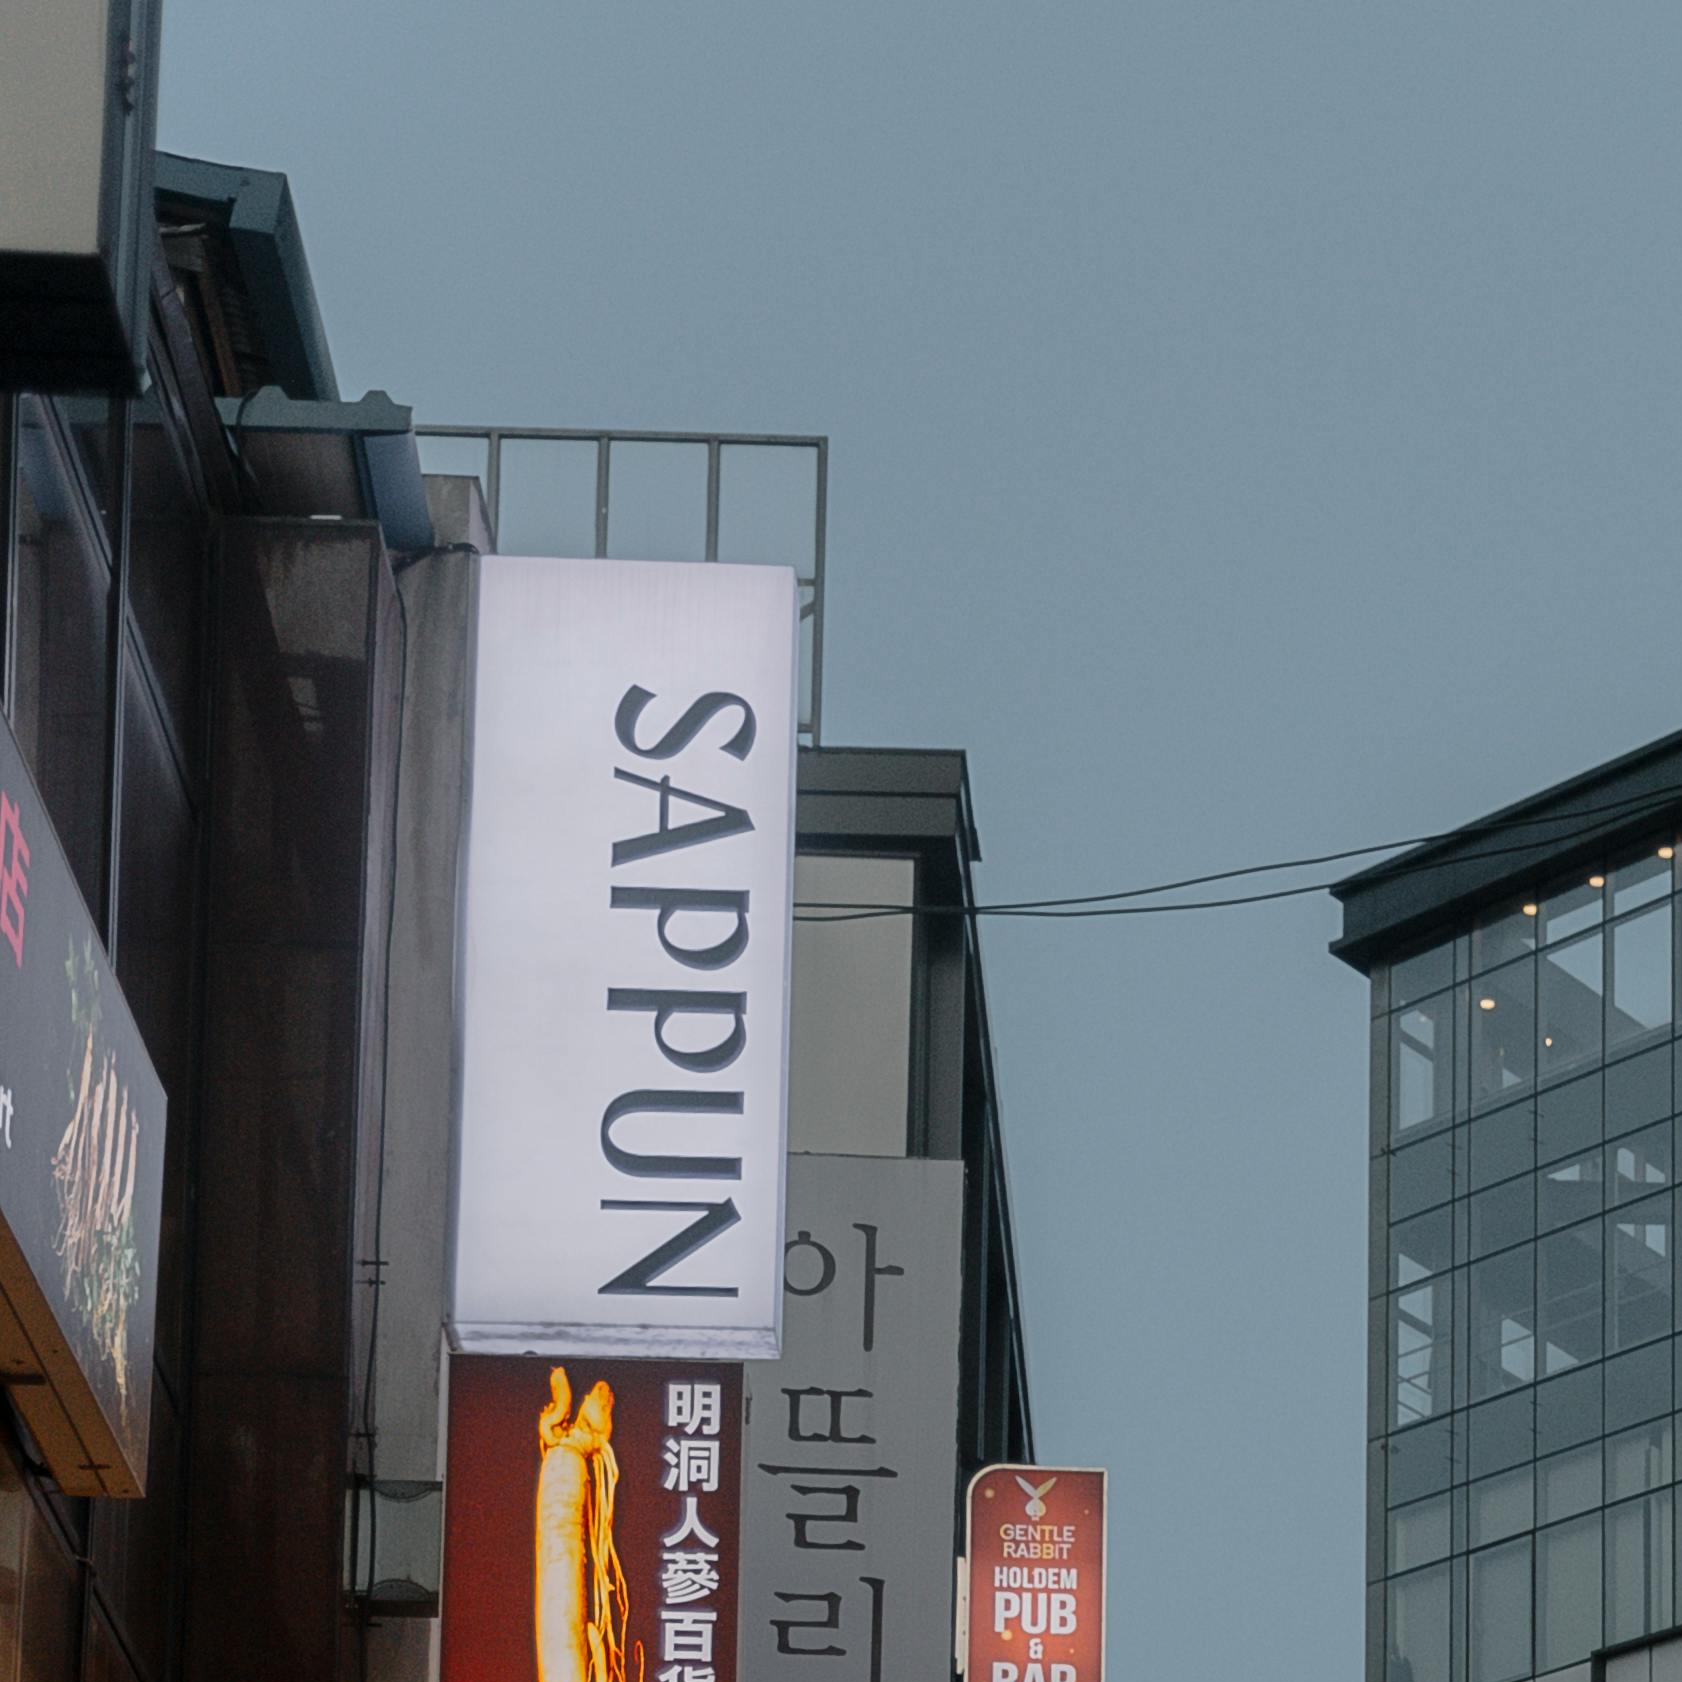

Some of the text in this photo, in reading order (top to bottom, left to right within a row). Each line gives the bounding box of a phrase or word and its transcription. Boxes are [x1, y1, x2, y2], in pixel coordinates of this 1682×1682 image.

[598, 684, 758, 1299] SAPPUN
[1000, 1525, 1075, 1542] GENTLE
[1003, 1543, 1072, 1560] RABBIT
[994, 1567, 1078, 1590] HOLDEM
[994, 1591, 1077, 1635] PUB
[1029, 1638, 1043, 1659] &
